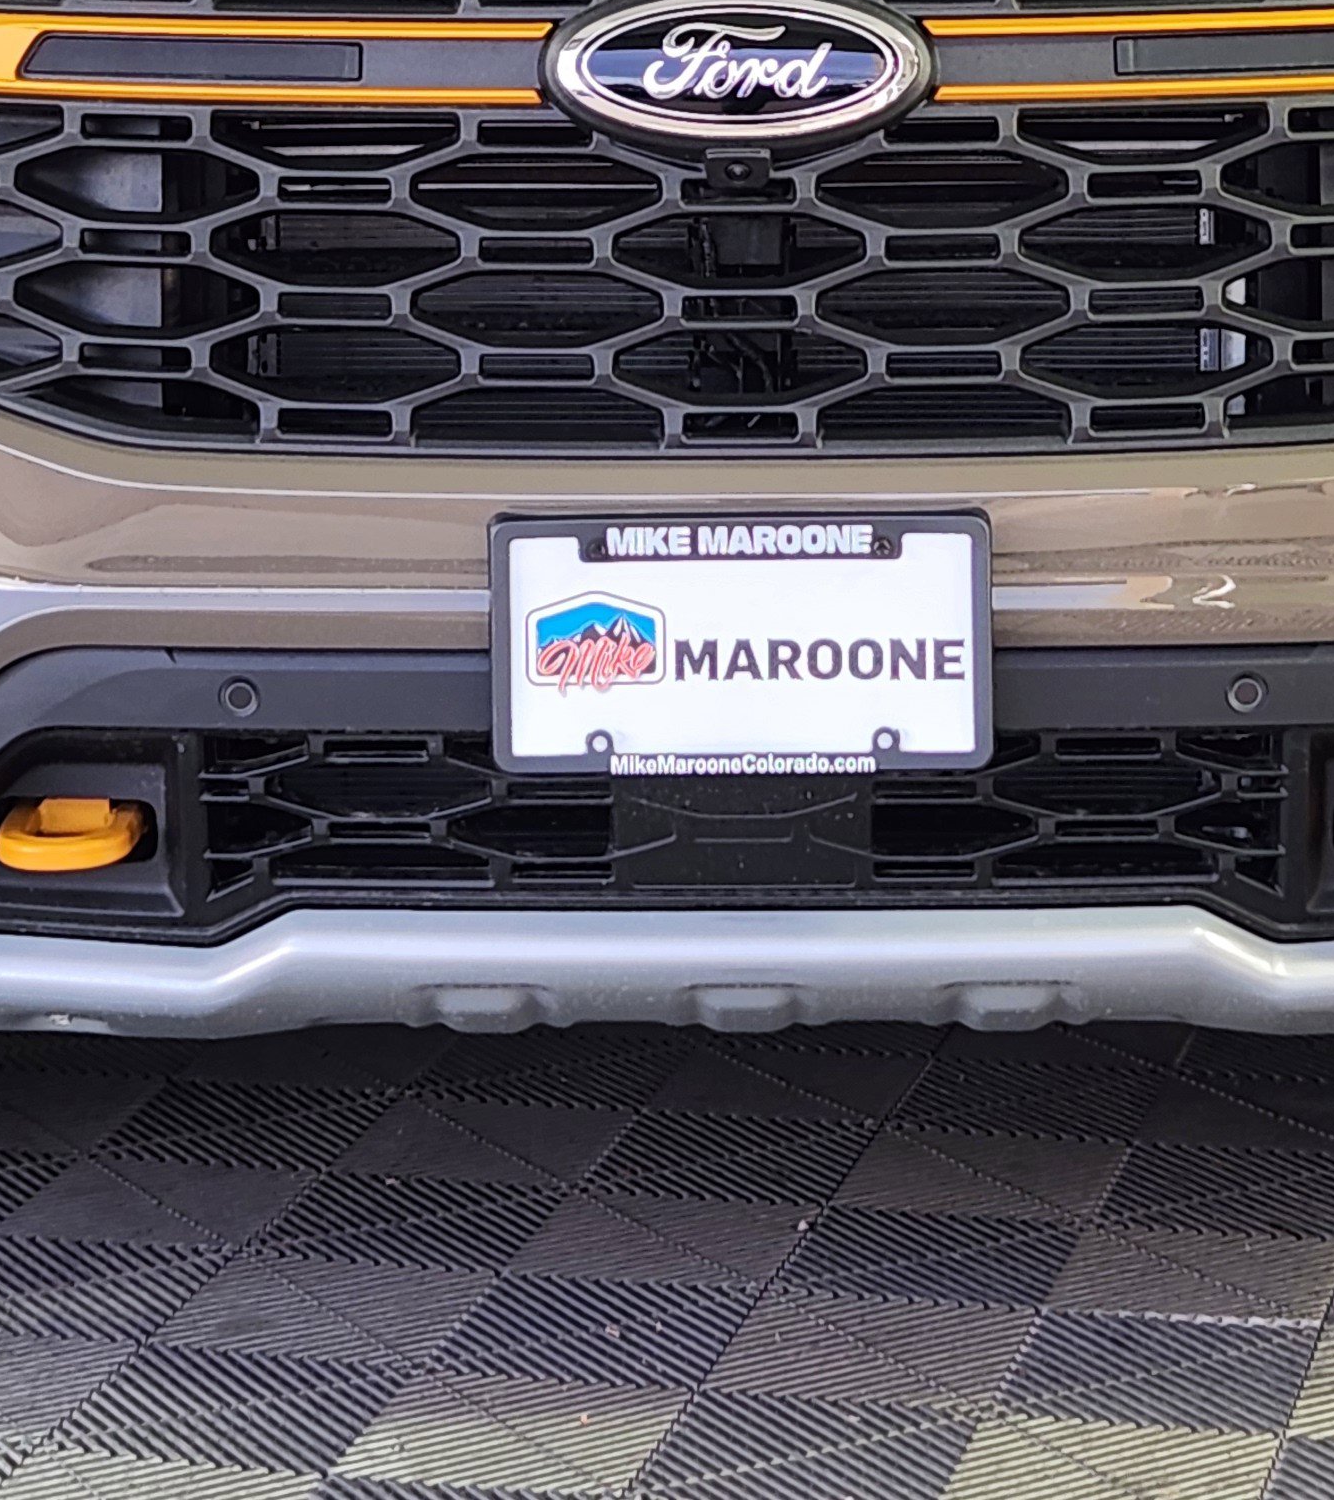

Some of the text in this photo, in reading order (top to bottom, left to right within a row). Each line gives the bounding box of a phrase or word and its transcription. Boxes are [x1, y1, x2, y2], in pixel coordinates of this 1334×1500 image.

[643, 21, 833, 100] Ford
[606, 525, 873, 556] MIKE MAROONE
[537, 631, 656, 692] Mike
[674, 638, 966, 681] MAROONE
[610, 753, 876, 777] MikeMarooneColorado.com
